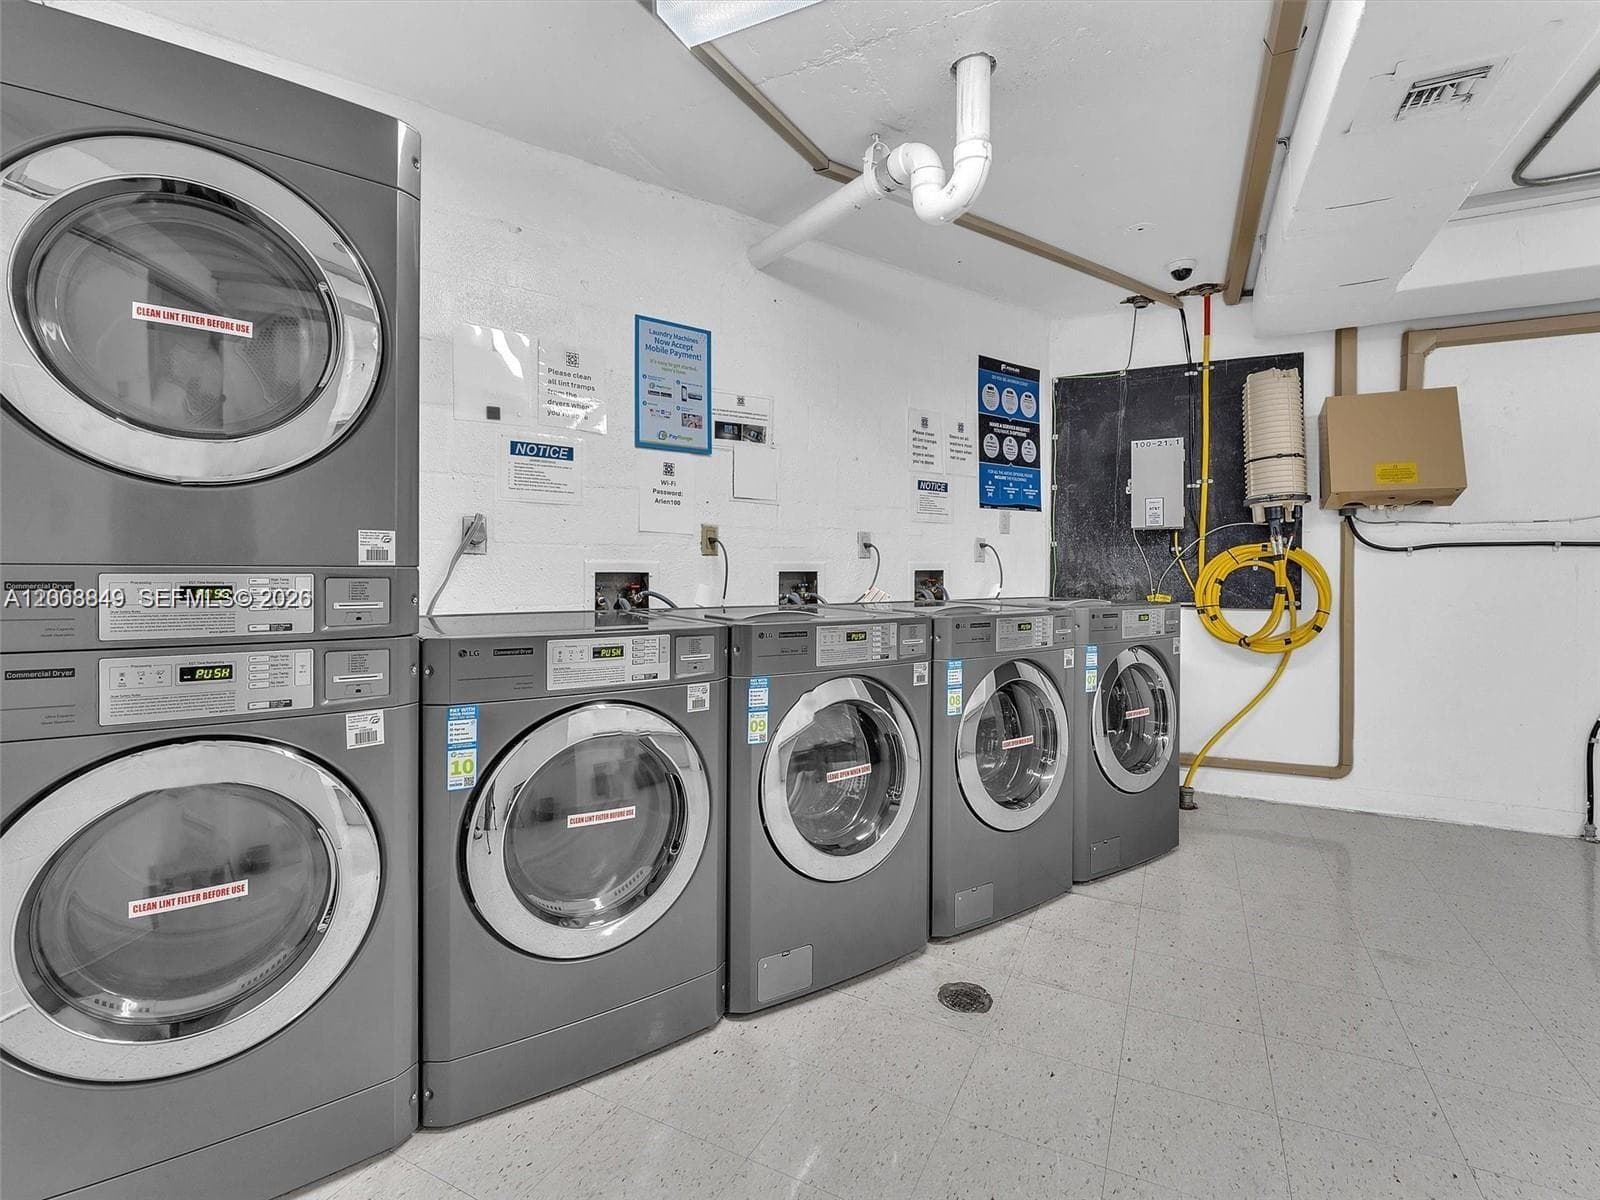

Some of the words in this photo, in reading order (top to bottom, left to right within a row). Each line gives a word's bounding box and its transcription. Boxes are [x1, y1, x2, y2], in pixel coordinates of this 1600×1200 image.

[136, 306, 160, 318] CLEAN
[163, 310, 179, 320] LINT
[181, 314, 205, 326] FILTER
[206, 318, 234, 330] BEFORE
[236, 324, 250, 334] USE
[648, 328, 672, 340] Laundry
[674, 334, 698, 344] Machines
[654, 337, 670, 346] Now
[671, 340, 694, 351] Accept
[645, 344, 668, 354] Mobile
[670, 348, 702, 360] Payment!
[548, 368, 571, 378] Please
[572, 371, 592, 381] clean
[558, 380, 570, 388] lint
[570, 381, 595, 392] tramps
[516, 443, 568, 459] NOTICE
[653, 488, 683, 497] Password:
[920, 482, 946, 492] NOTICE
[601, 648, 621, 657] PUSH
[6, 670, 50, 679] Commercial
[52, 669, 74, 678] Dryer
[195, 668, 230, 680] PUSH
[950, 696, 960, 706] 08
[750, 720, 766, 732] 09
[451, 759, 474, 775] 10
[133, 903, 157, 913] CLEAN
[159, 898, 176, 909] LINT
[178, 894, 201, 905] FILTER
[203, 888, 230, 900] BEFORE
[231, 884, 245, 894] USE
